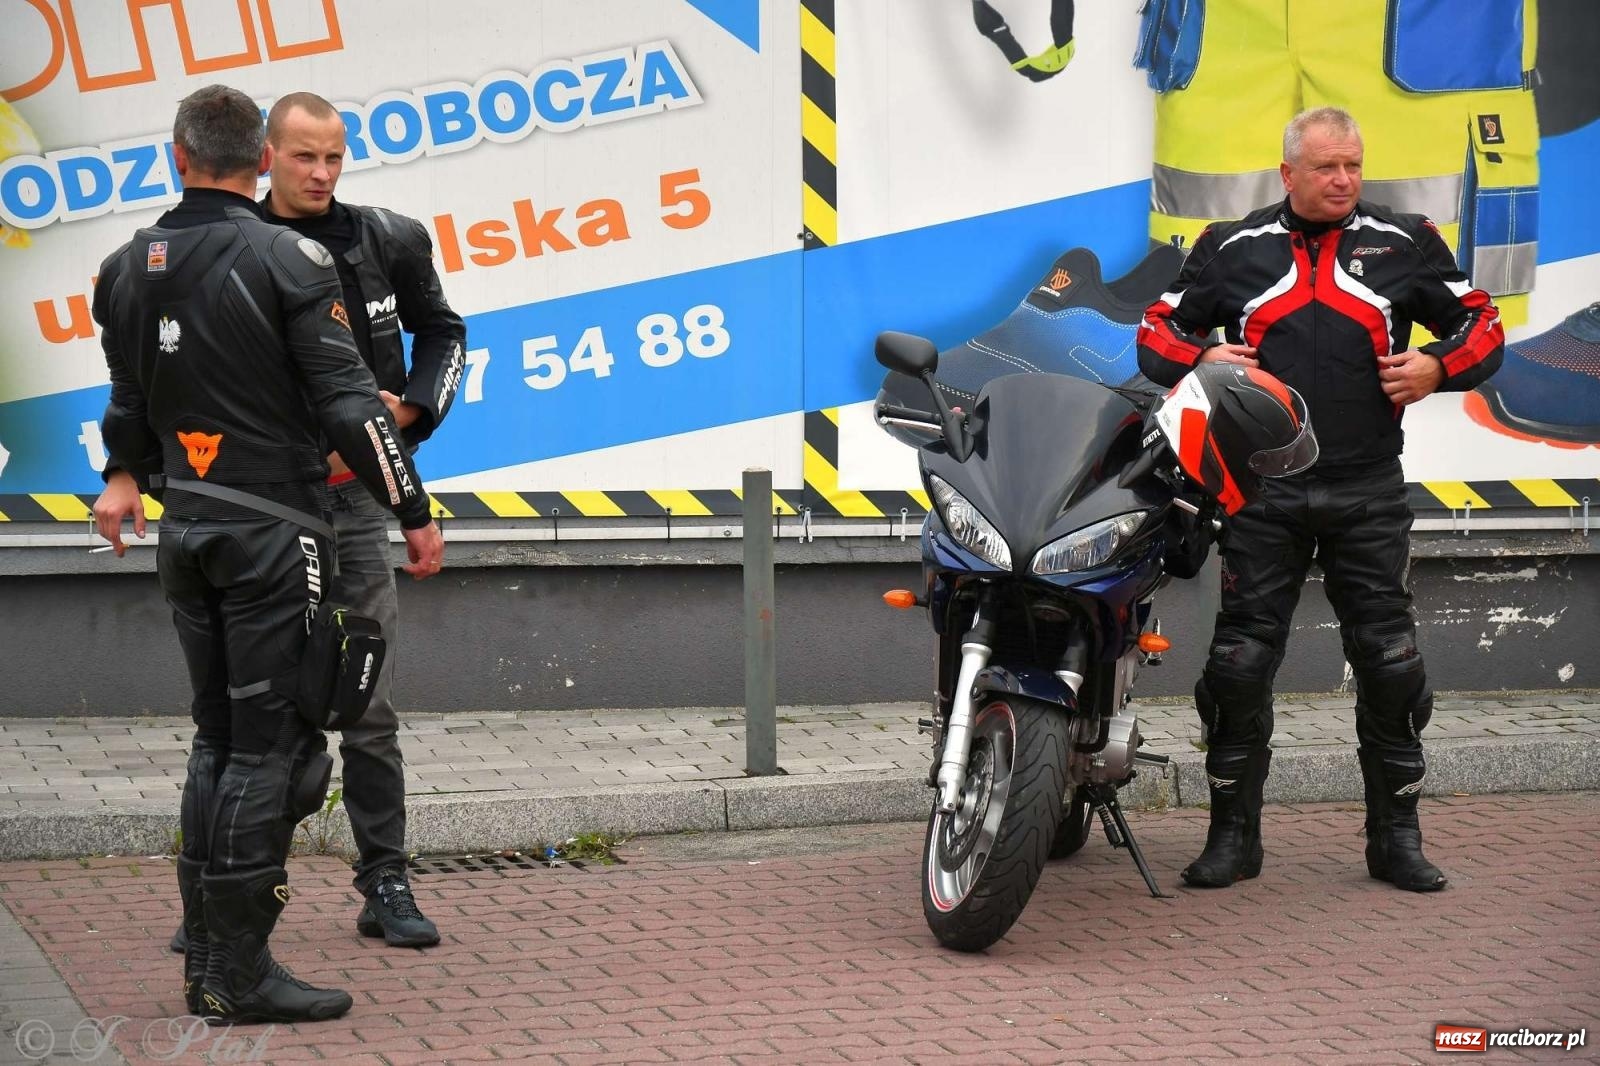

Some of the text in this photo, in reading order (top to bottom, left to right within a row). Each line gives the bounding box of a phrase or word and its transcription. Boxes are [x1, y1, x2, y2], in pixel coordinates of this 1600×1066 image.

[338, 50, 690, 161] ROBOCZA
[433, 198, 632, 272] lska
[659, 168, 712, 230] 5
[463, 347, 491, 404] 7
[522, 325, 615, 391] 54
[636, 303, 731, 368] 88
[375, 416, 417, 498] DAINESE
